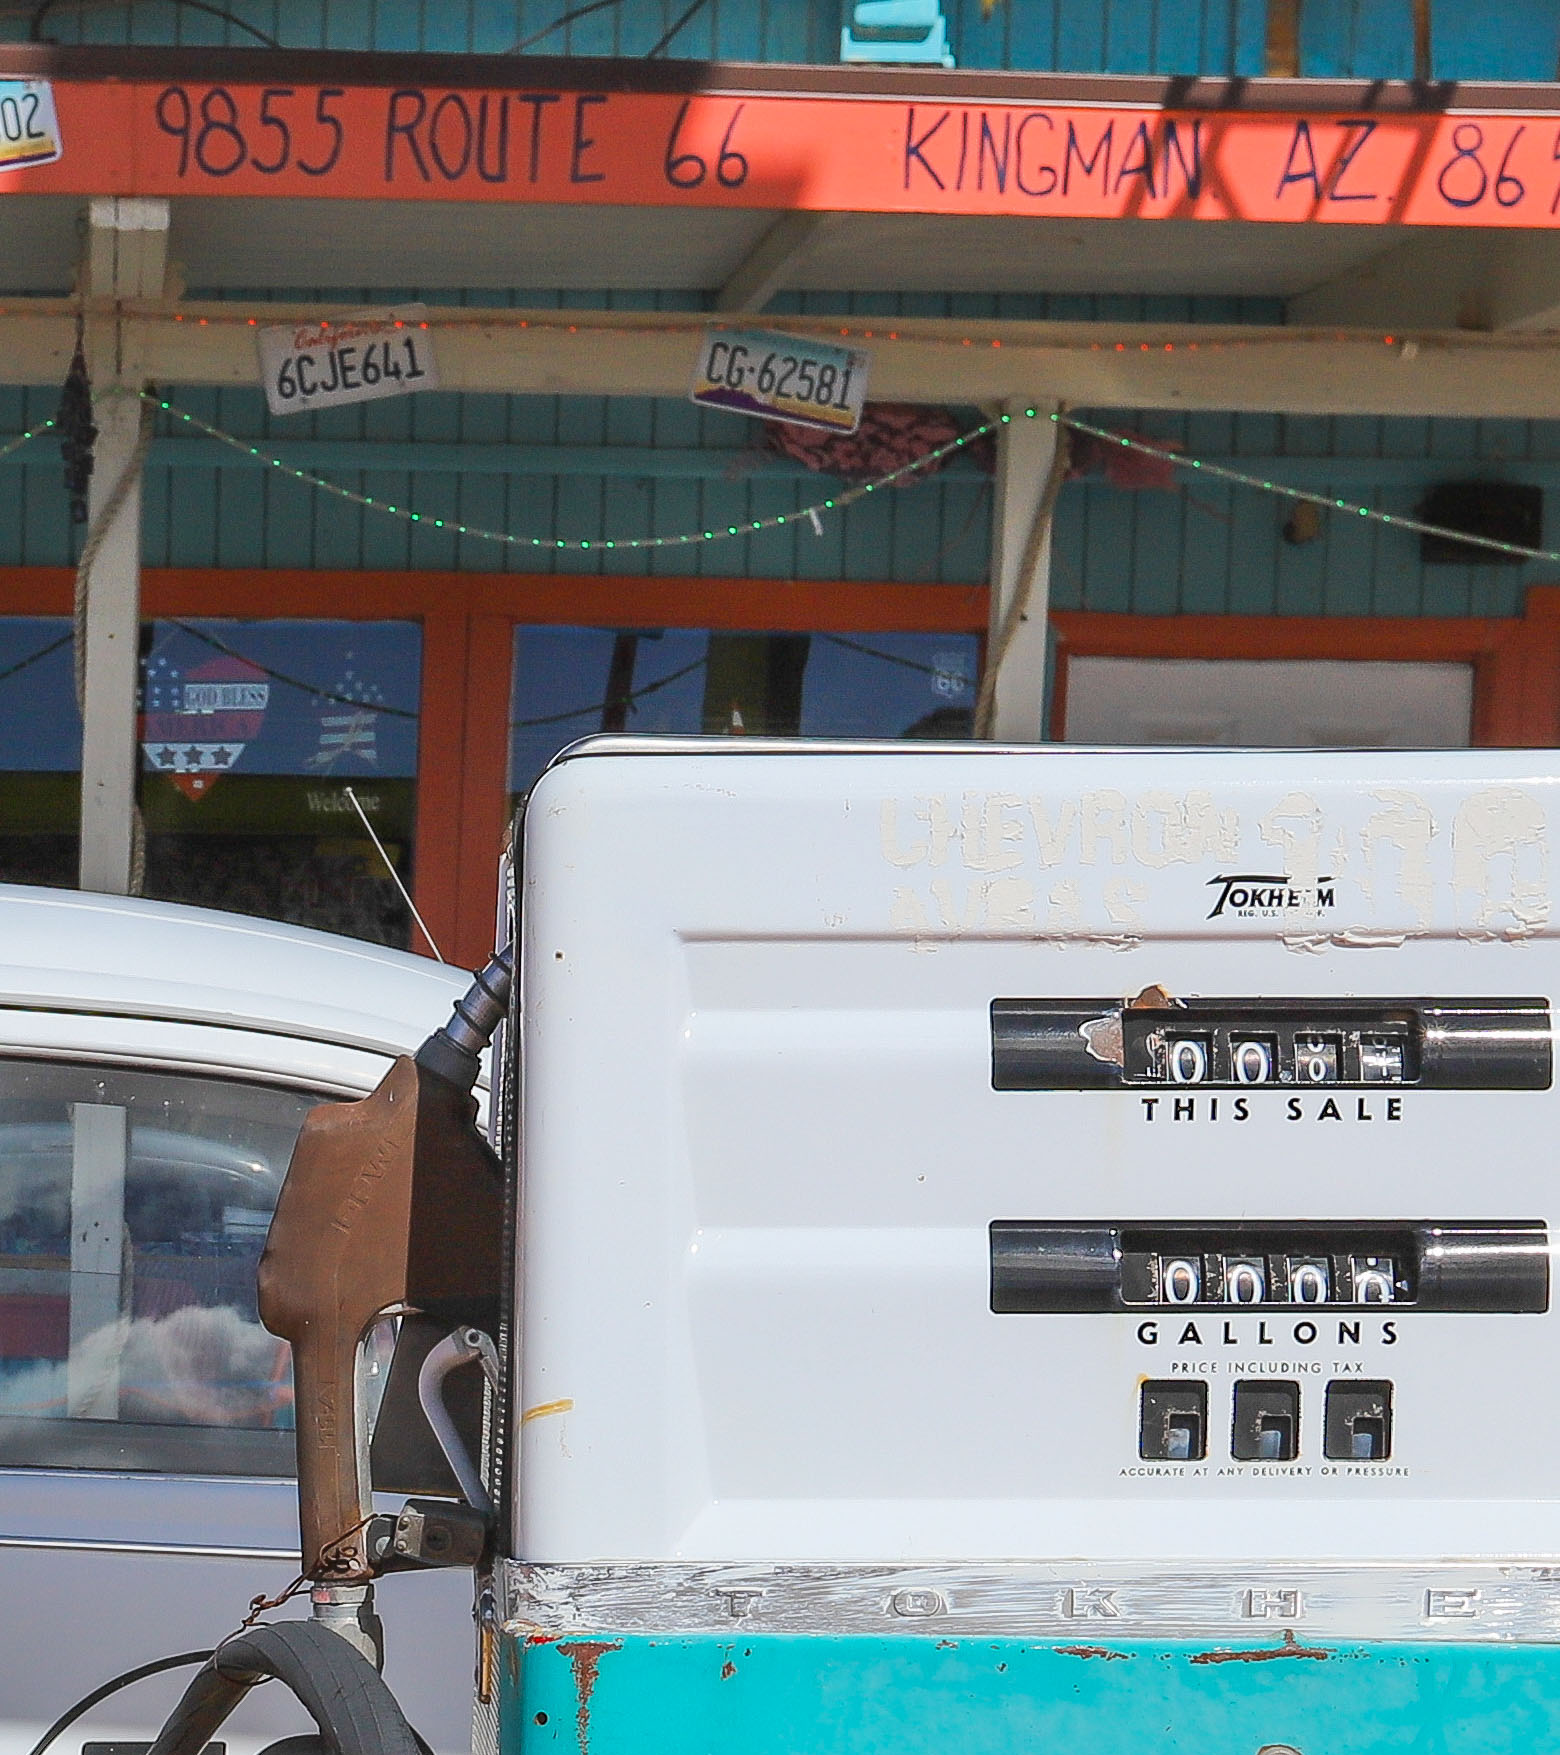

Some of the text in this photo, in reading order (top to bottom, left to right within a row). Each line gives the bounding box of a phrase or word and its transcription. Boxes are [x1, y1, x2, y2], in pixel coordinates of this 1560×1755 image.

[155, 88, 344, 177] 9855
[384, 91, 608, 184] ROUTE
[665, 98, 749, 189] 66
[904, 107, 1202, 201] KINGMAN
[1277, 118, 1382, 201] AZ
[277, 335, 425, 400] 6CJE641
[1206, 873, 1337, 920] TOKHEM
[1140, 1097, 1403, 1122] THIS SALE
[1136, 1320, 1398, 1345] GALLONS
[1171, 1362, 1364, 1374] PRICE INCLUDING TAX
[1119, 1466, 1410, 1478] ACCURATE AT ANY DELIVERY OR PRESSURE
